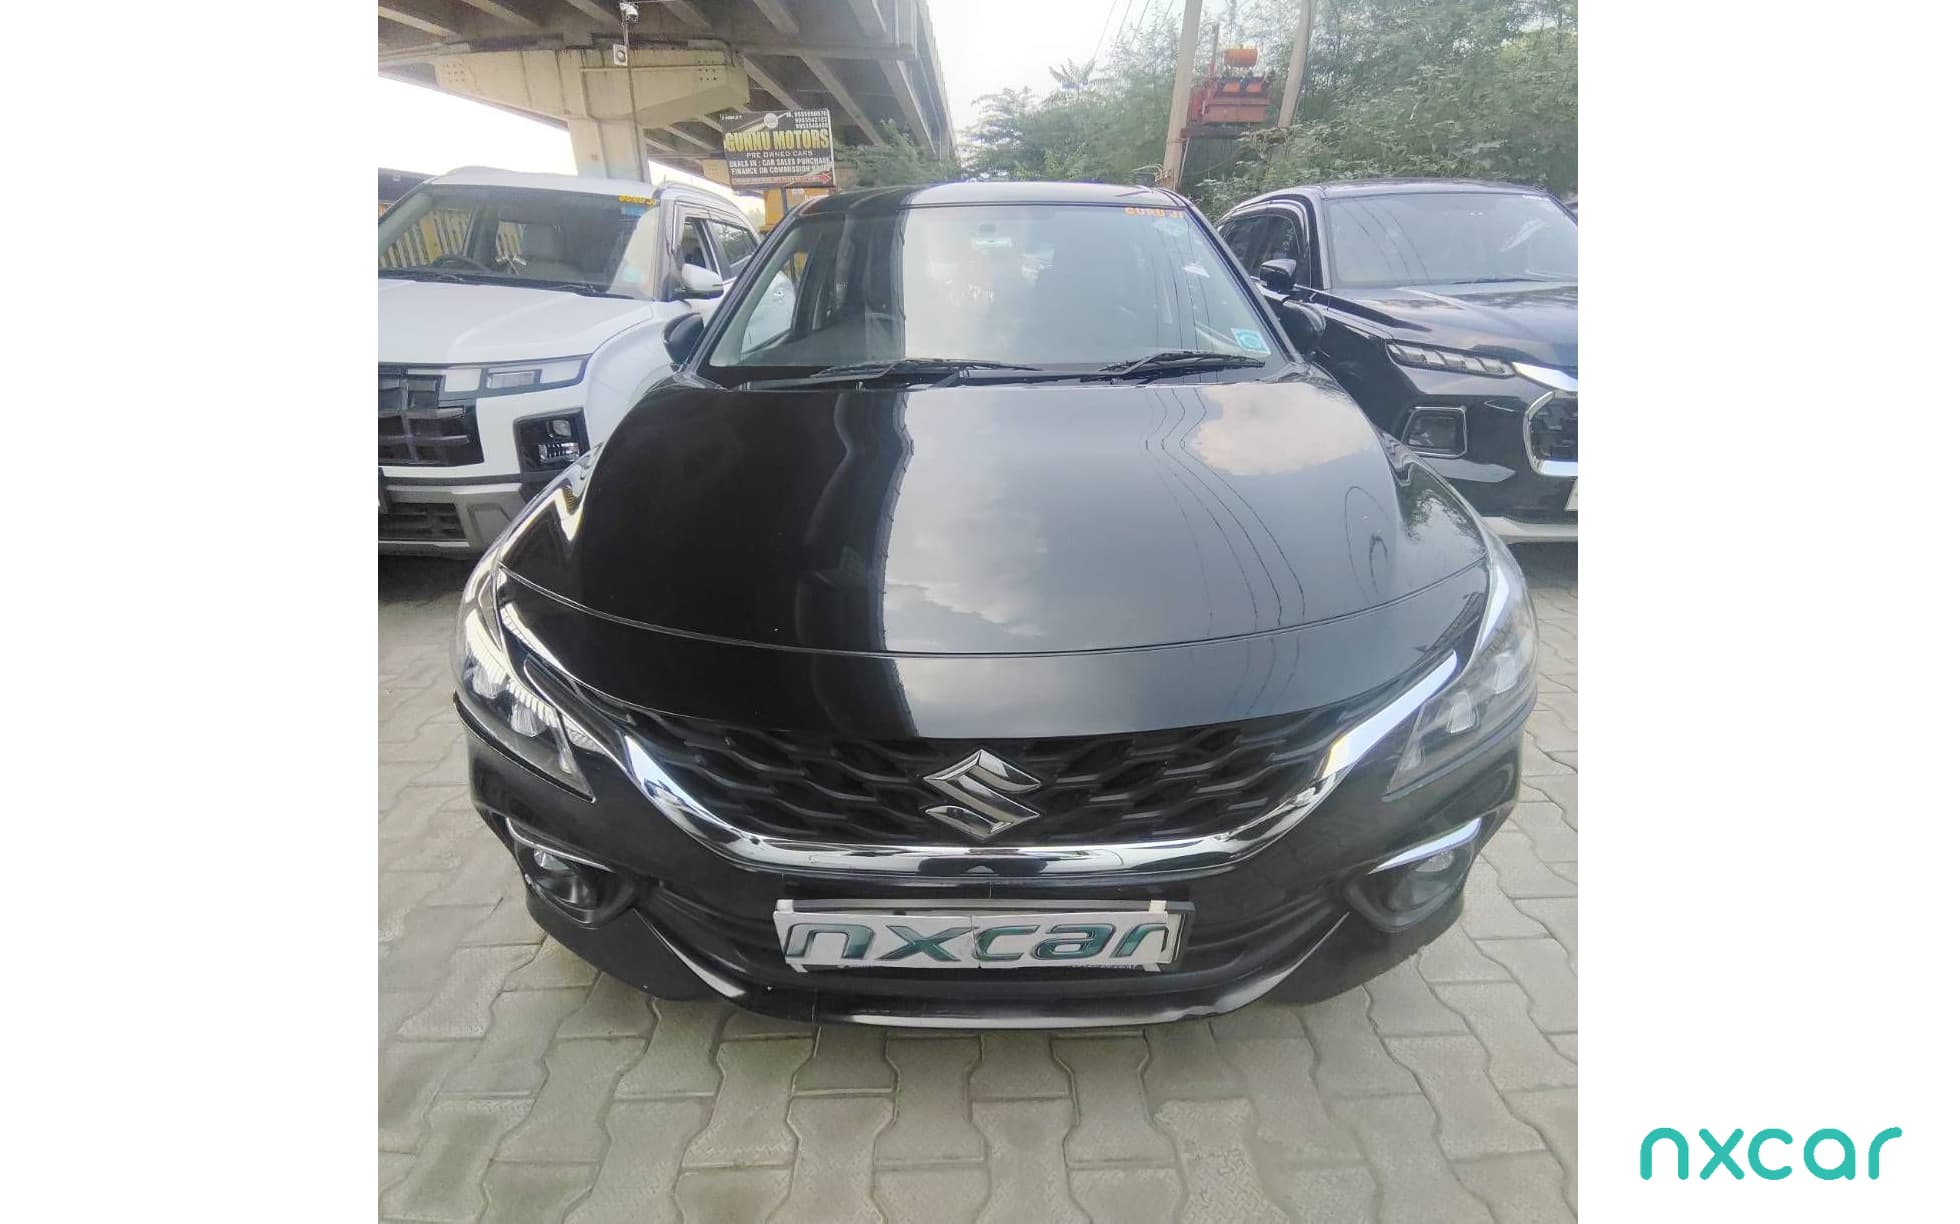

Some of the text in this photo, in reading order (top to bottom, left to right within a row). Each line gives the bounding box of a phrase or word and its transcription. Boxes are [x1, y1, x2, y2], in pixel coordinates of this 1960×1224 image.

[725, 129, 829, 151] GUNNU MOTORS
[731, 167, 758, 175] FINANCE
[770, 165, 810, 174] COMMISSION
[762, 159, 776, 167] CAR
[777, 158, 796, 166] SALES
[786, 922, 1169, 961] nxcar
